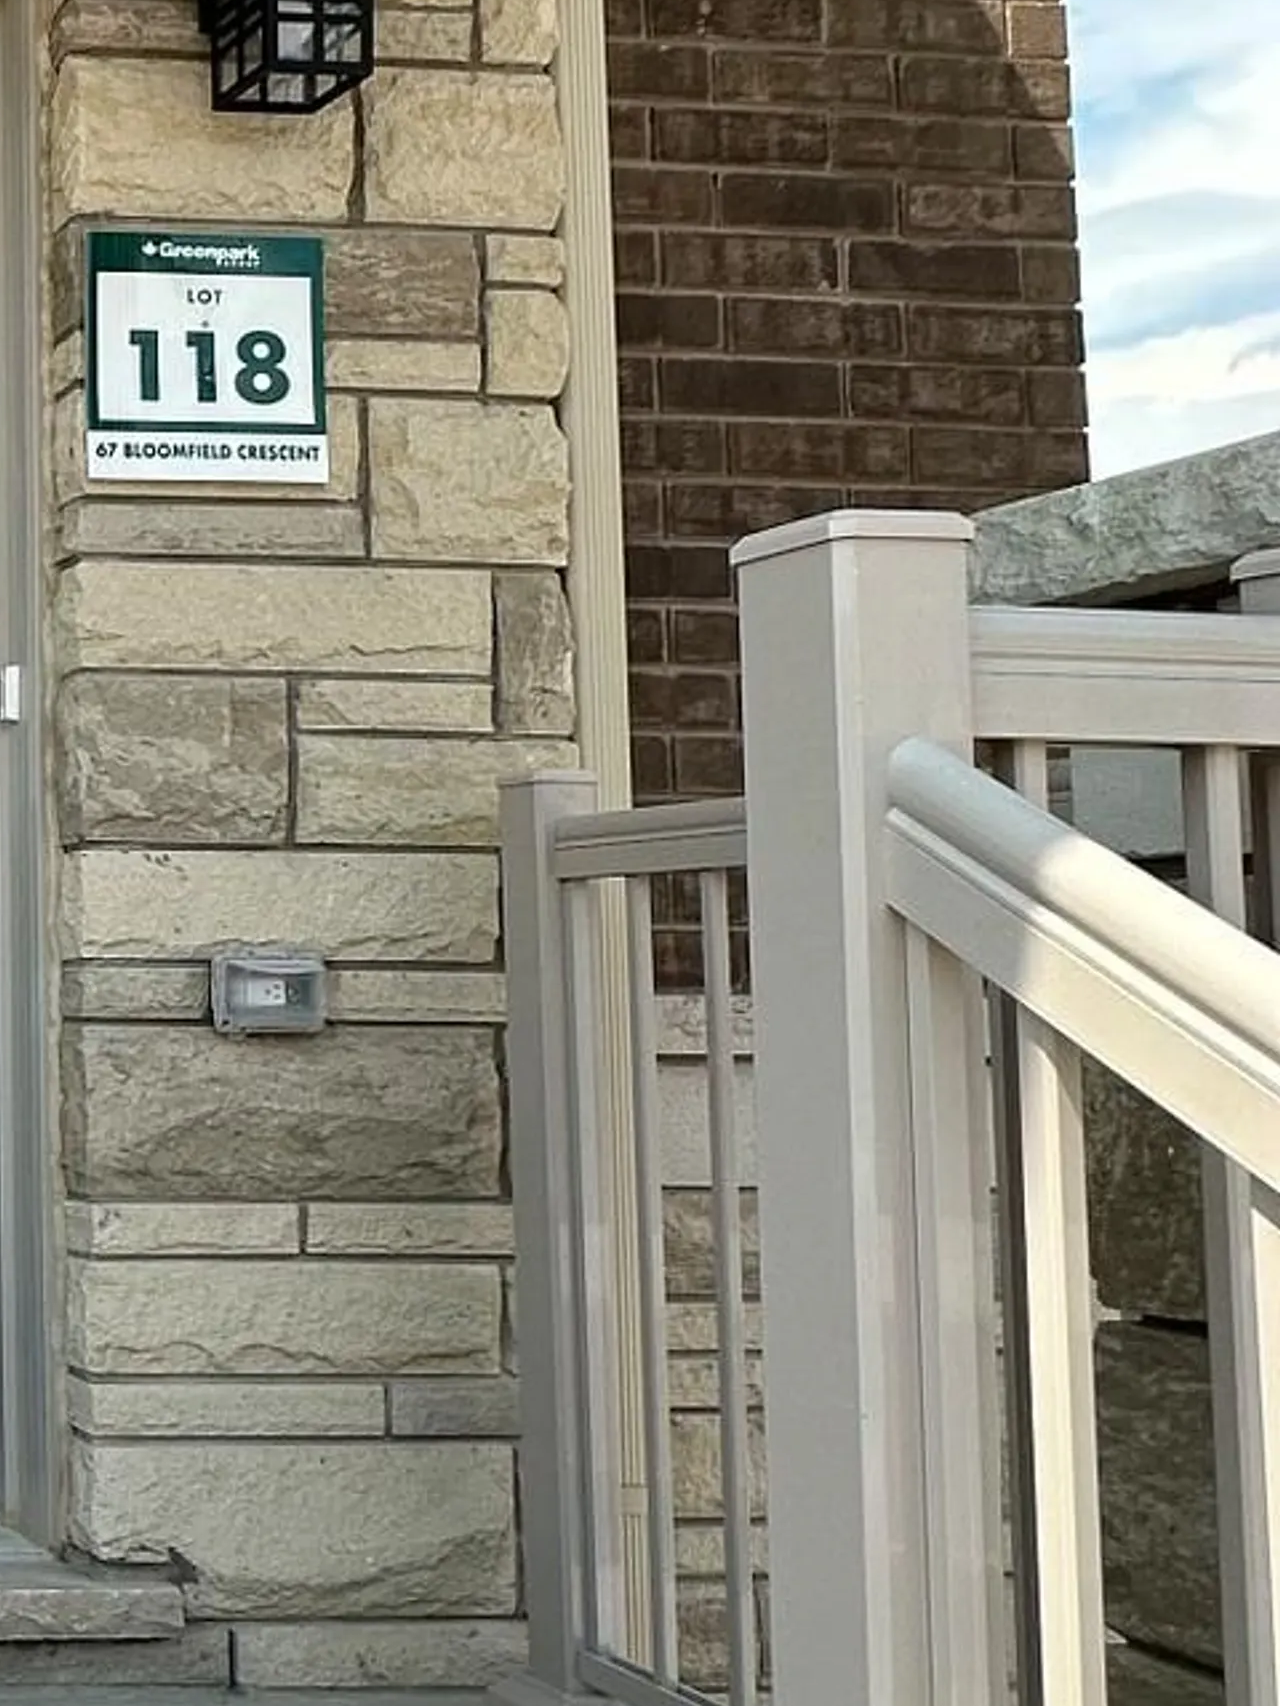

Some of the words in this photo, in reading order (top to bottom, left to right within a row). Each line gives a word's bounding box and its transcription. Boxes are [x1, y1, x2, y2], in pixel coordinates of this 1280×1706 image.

[160, 242, 260, 262] Greenpark
[188, 290, 222, 305] LOT
[129, 330, 290, 404] 118
[96, 444, 117, 459] 67
[123, 444, 231, 460] BLOOMFIELD
[238, 445, 320, 461] CRESCENT
